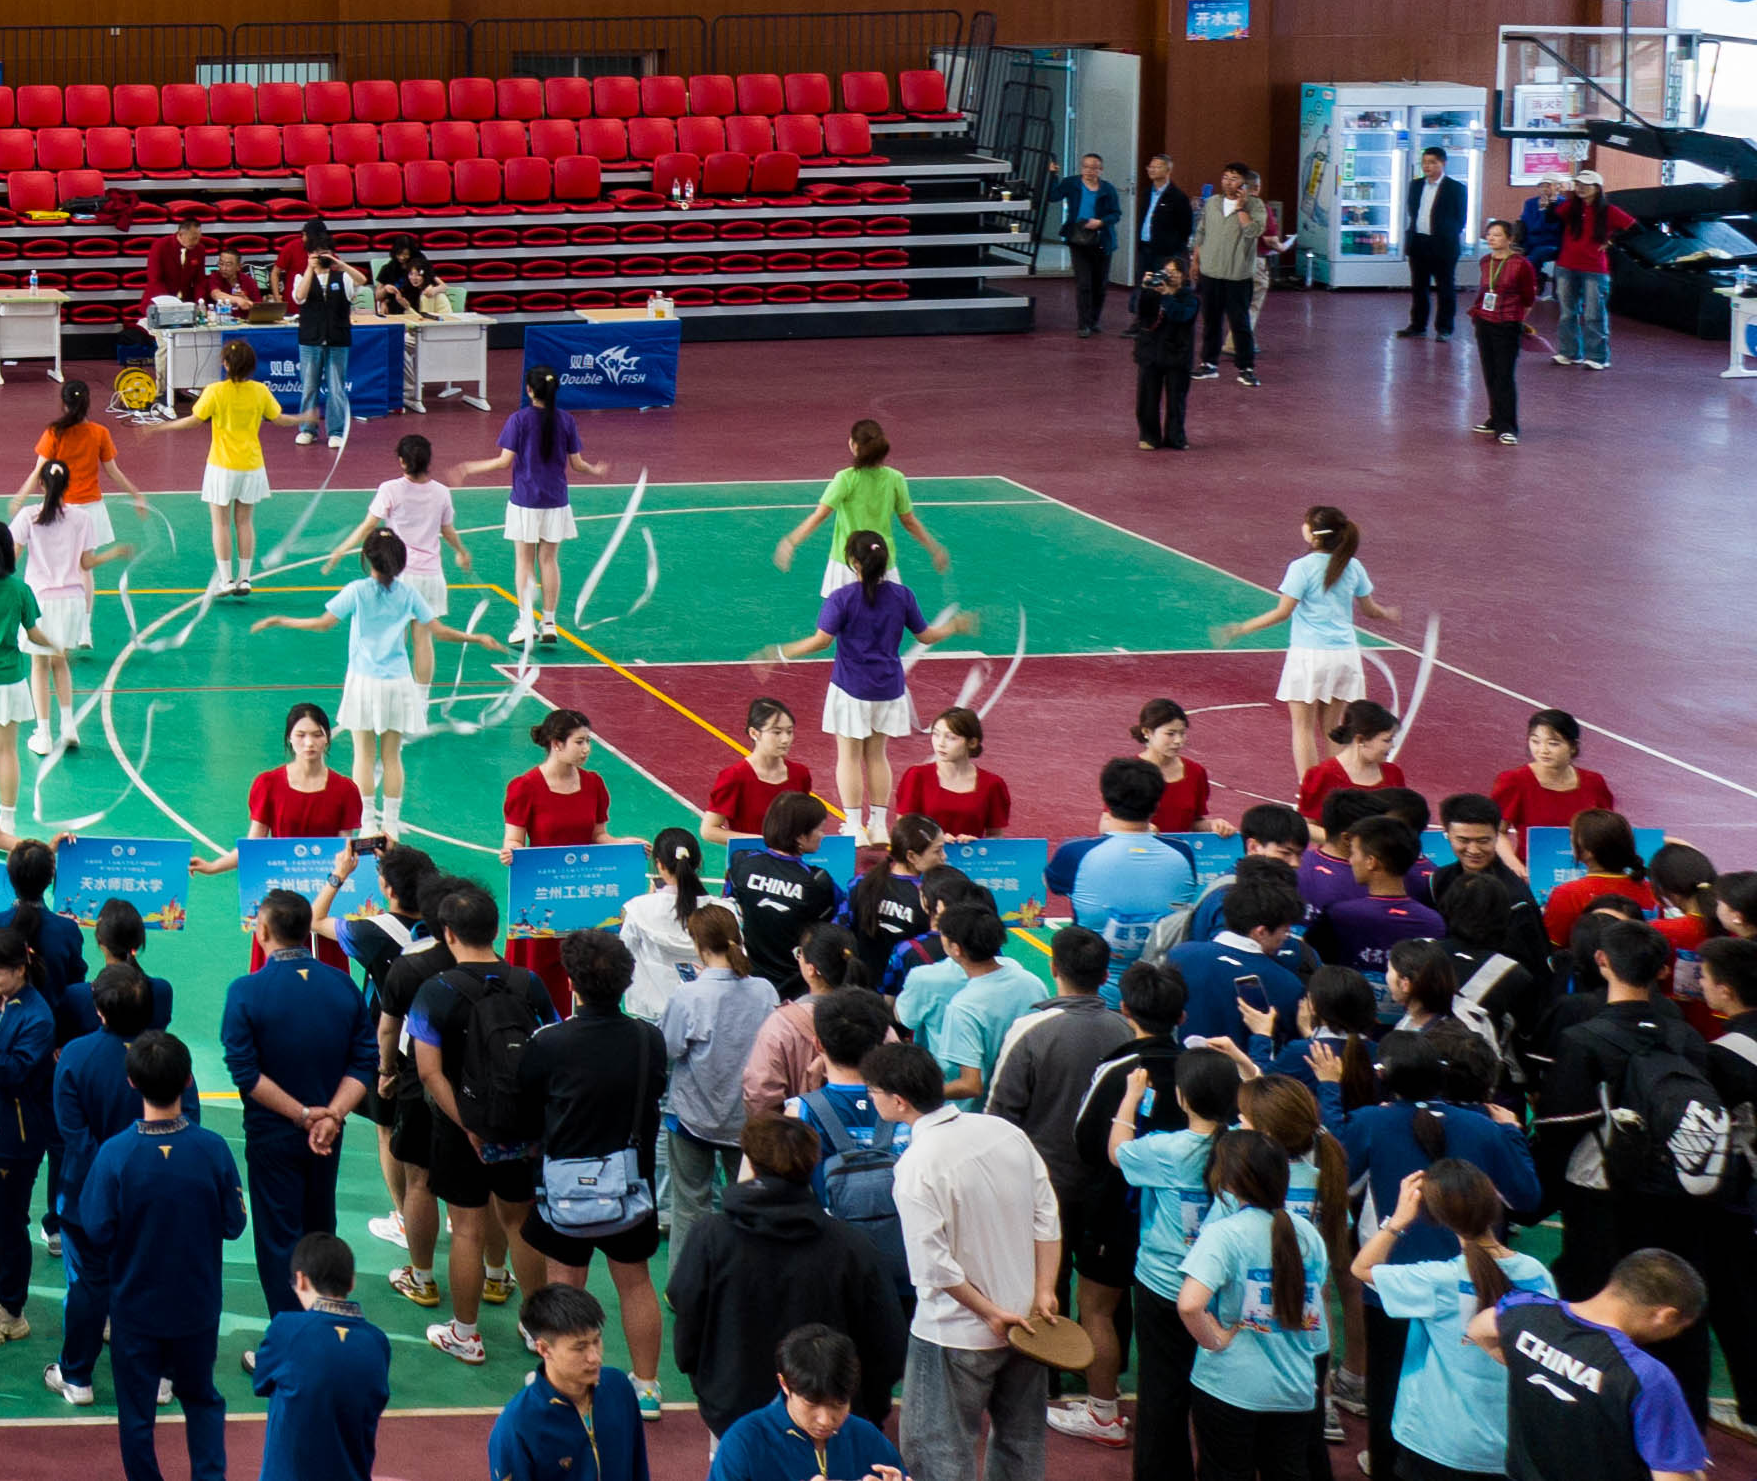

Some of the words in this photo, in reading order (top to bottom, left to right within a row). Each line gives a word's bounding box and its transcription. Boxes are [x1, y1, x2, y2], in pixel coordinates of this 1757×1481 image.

[560, 372, 603, 386] Double
[620, 373, 646, 385] FISH
[80, 876, 164, 894] 天水师范大学
[266, 877, 355, 894] 兰州城市院
[535, 882, 620, 901] 兰州工业学院
[747, 874, 803, 901] CHINA
[1515, 1330, 1603, 1395] CHINA
